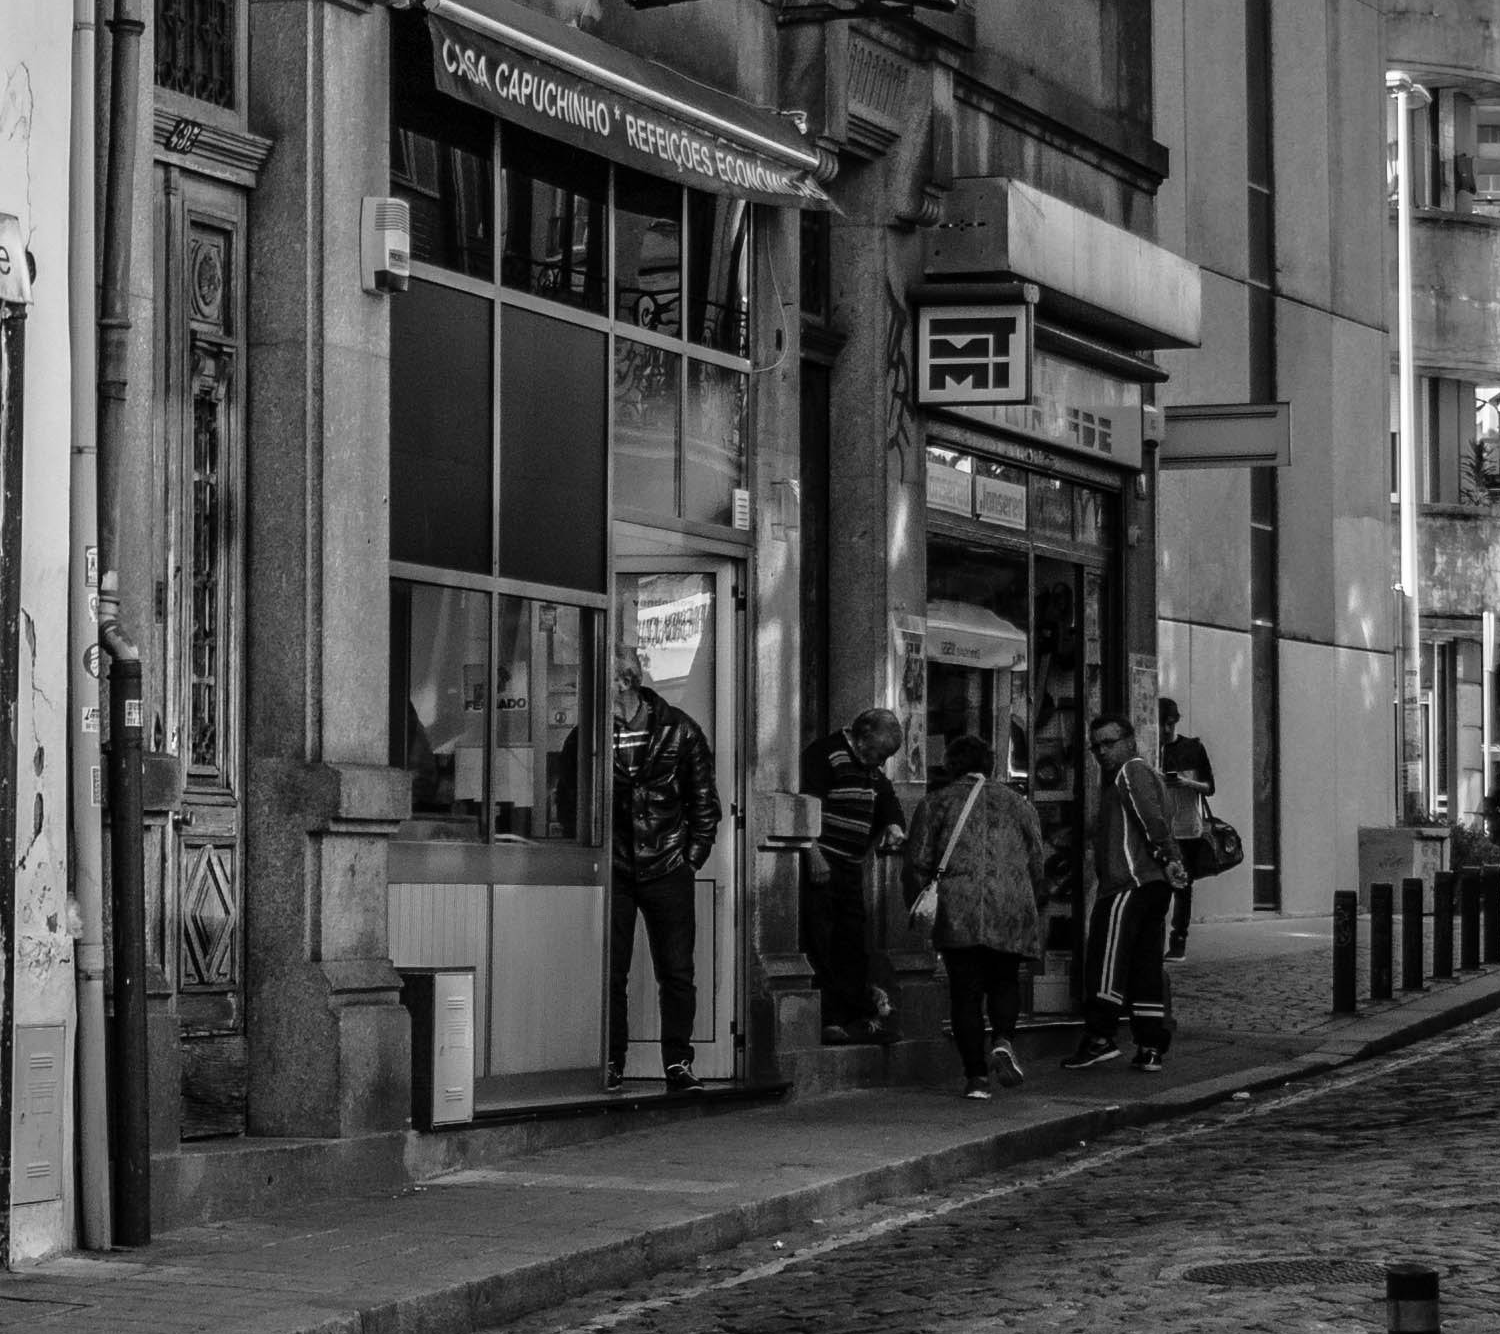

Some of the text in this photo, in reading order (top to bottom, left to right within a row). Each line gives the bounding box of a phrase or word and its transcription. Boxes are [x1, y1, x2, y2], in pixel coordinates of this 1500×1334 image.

[441, 39, 491, 87] CASA
[494, 62, 611, 138] CAPUCHINHO
[625, 117, 714, 178] REFEIÇÕES
[464, 697, 527, 712] FEADO
